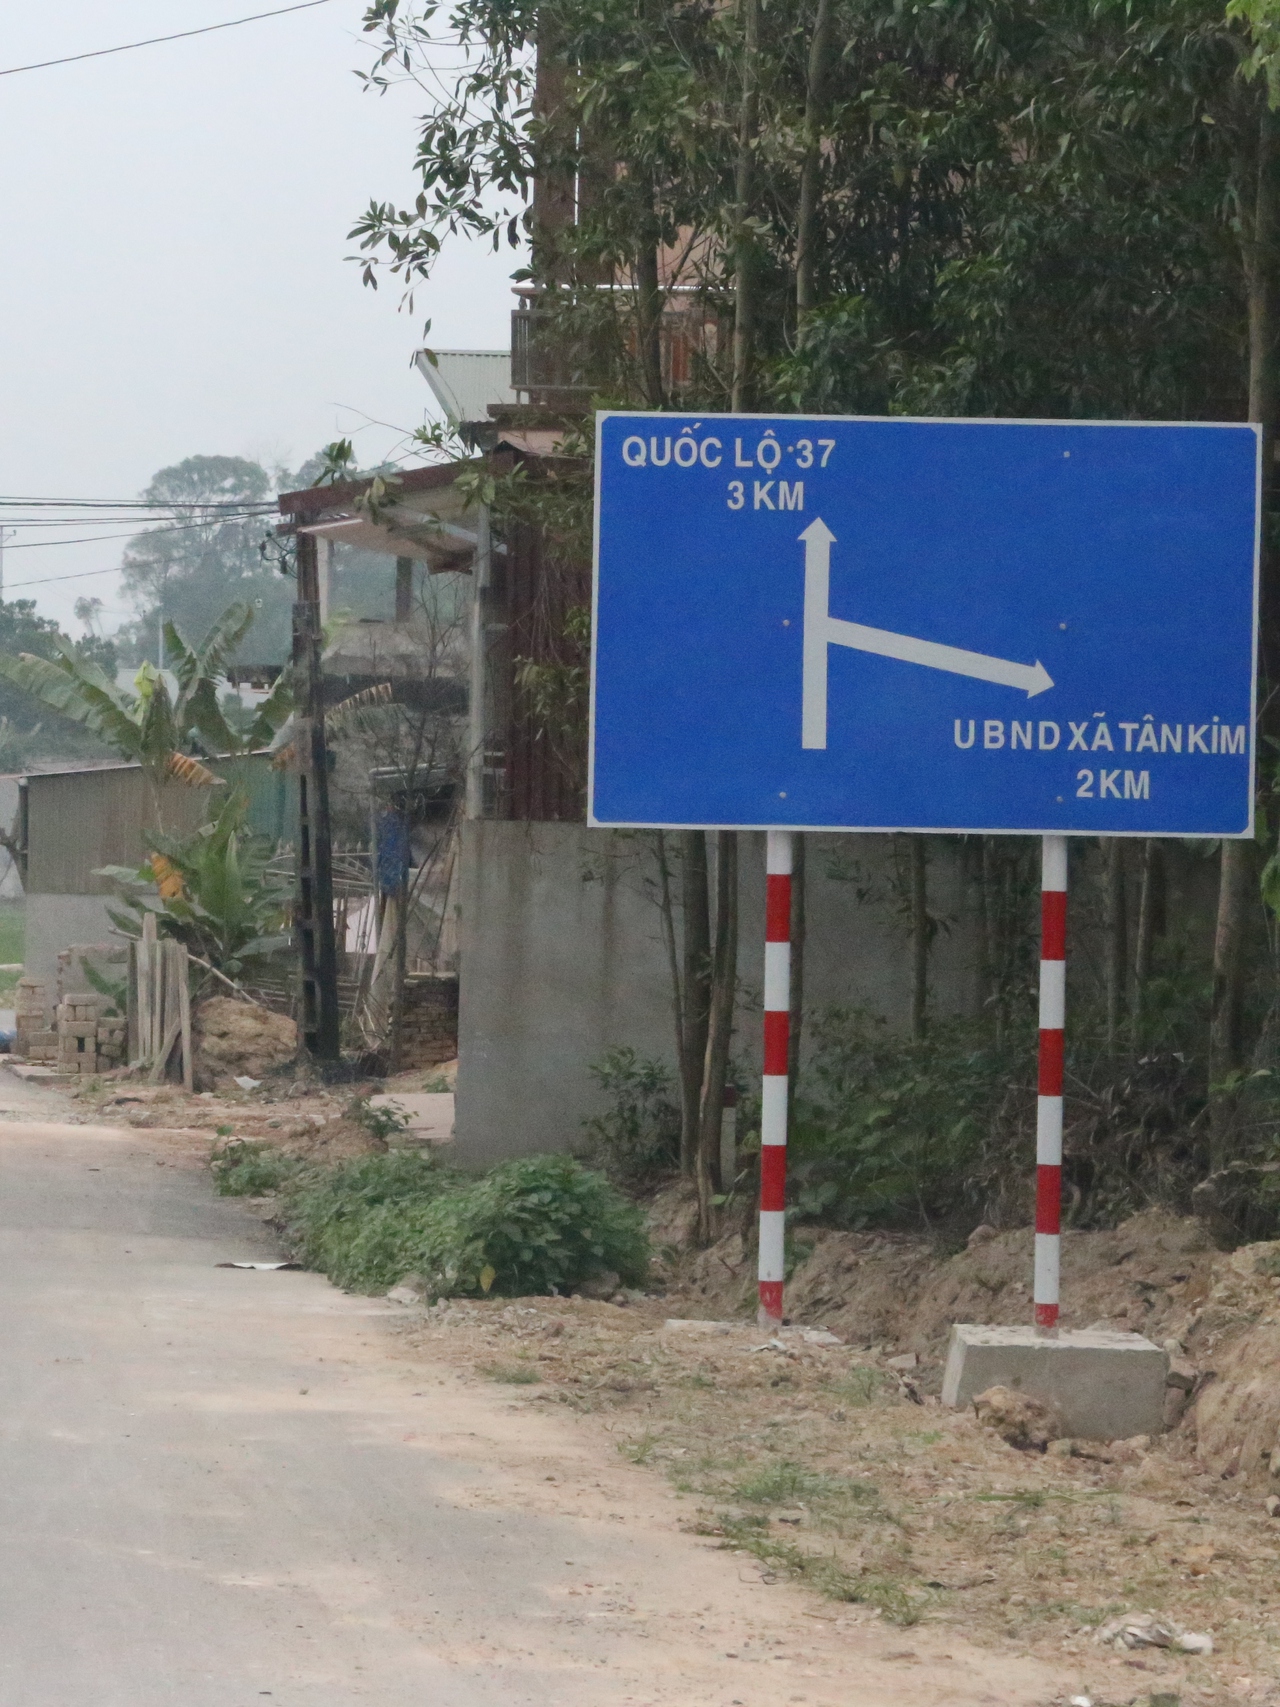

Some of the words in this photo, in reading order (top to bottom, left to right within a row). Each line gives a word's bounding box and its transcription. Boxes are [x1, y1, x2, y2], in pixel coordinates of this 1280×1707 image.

[622, 422, 722, 468] QUỐC
[734, 429, 782, 475] LỘ
[796, 438, 836, 469] 37
[727, 480, 745, 510] 3
[753, 480, 804, 511] KM
[954, 719, 1061, 750] UBND
[1067, 711, 1114, 752] XÃ
[1118, 714, 1182, 753] TÂN
[1076, 768, 1094, 798] 2
[1100, 769, 1150, 800] KM
